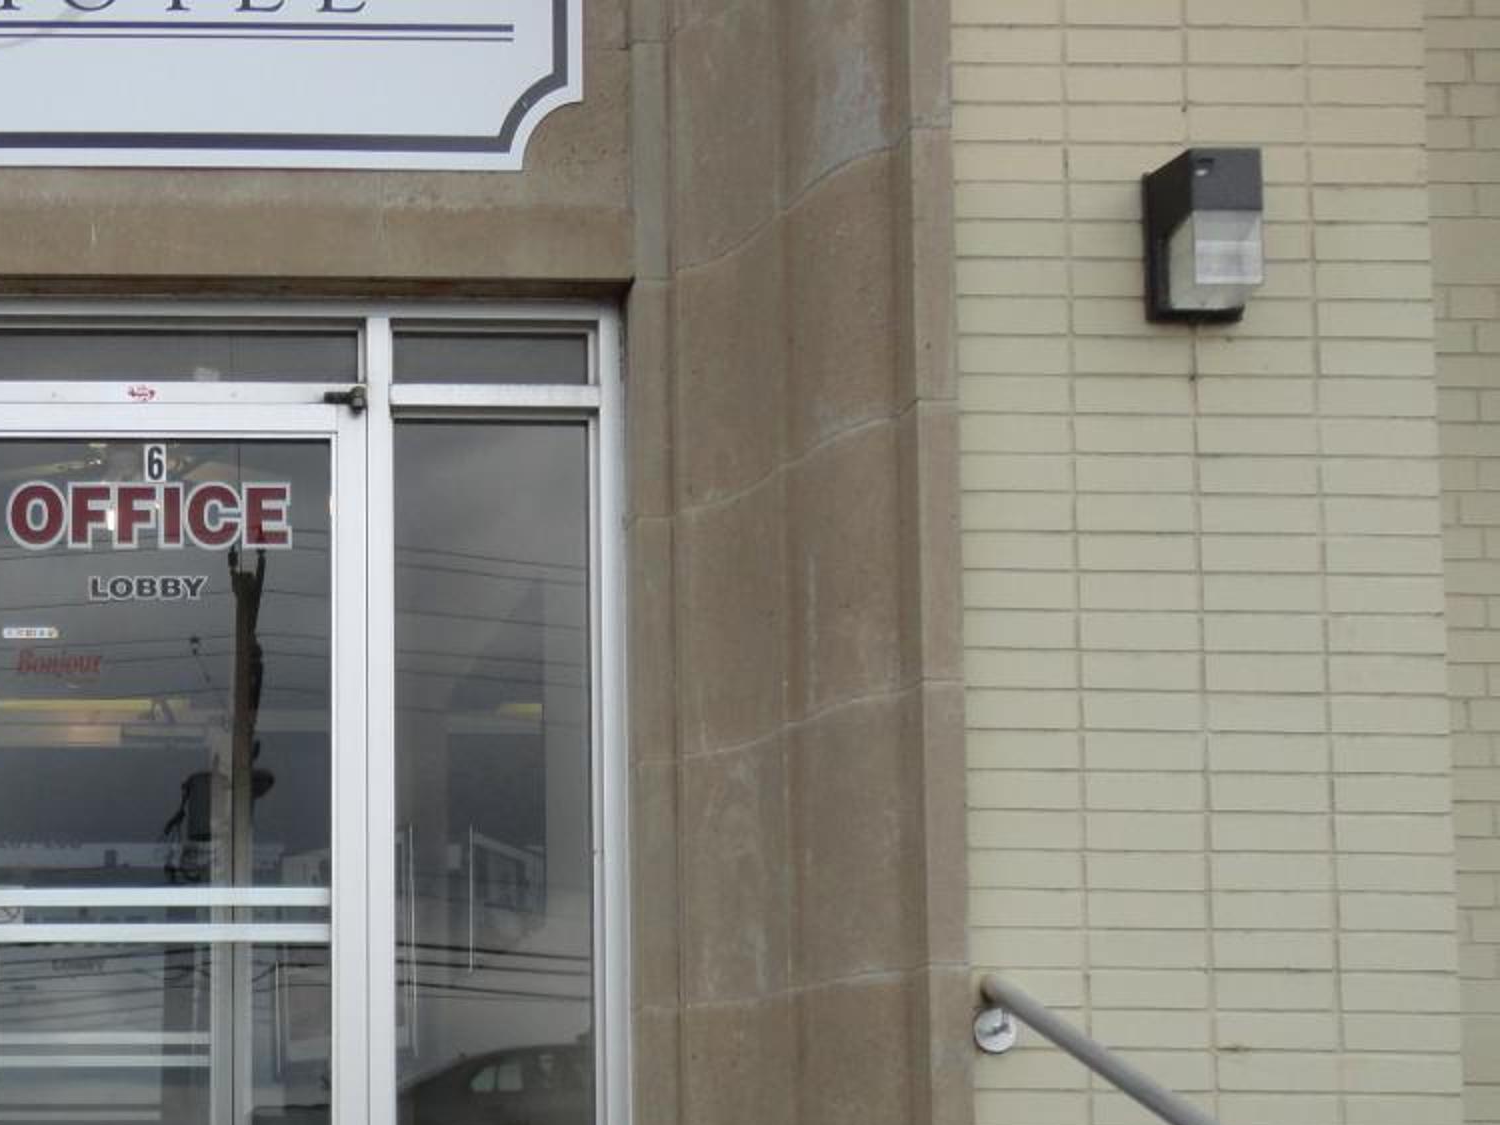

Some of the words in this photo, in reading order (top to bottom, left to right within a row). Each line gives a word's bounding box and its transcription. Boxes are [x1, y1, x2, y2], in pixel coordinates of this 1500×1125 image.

[146, 445, 164, 480] 6
[7, 482, 292, 549] OFFICE
[88, 575, 209, 600] LOBBY
